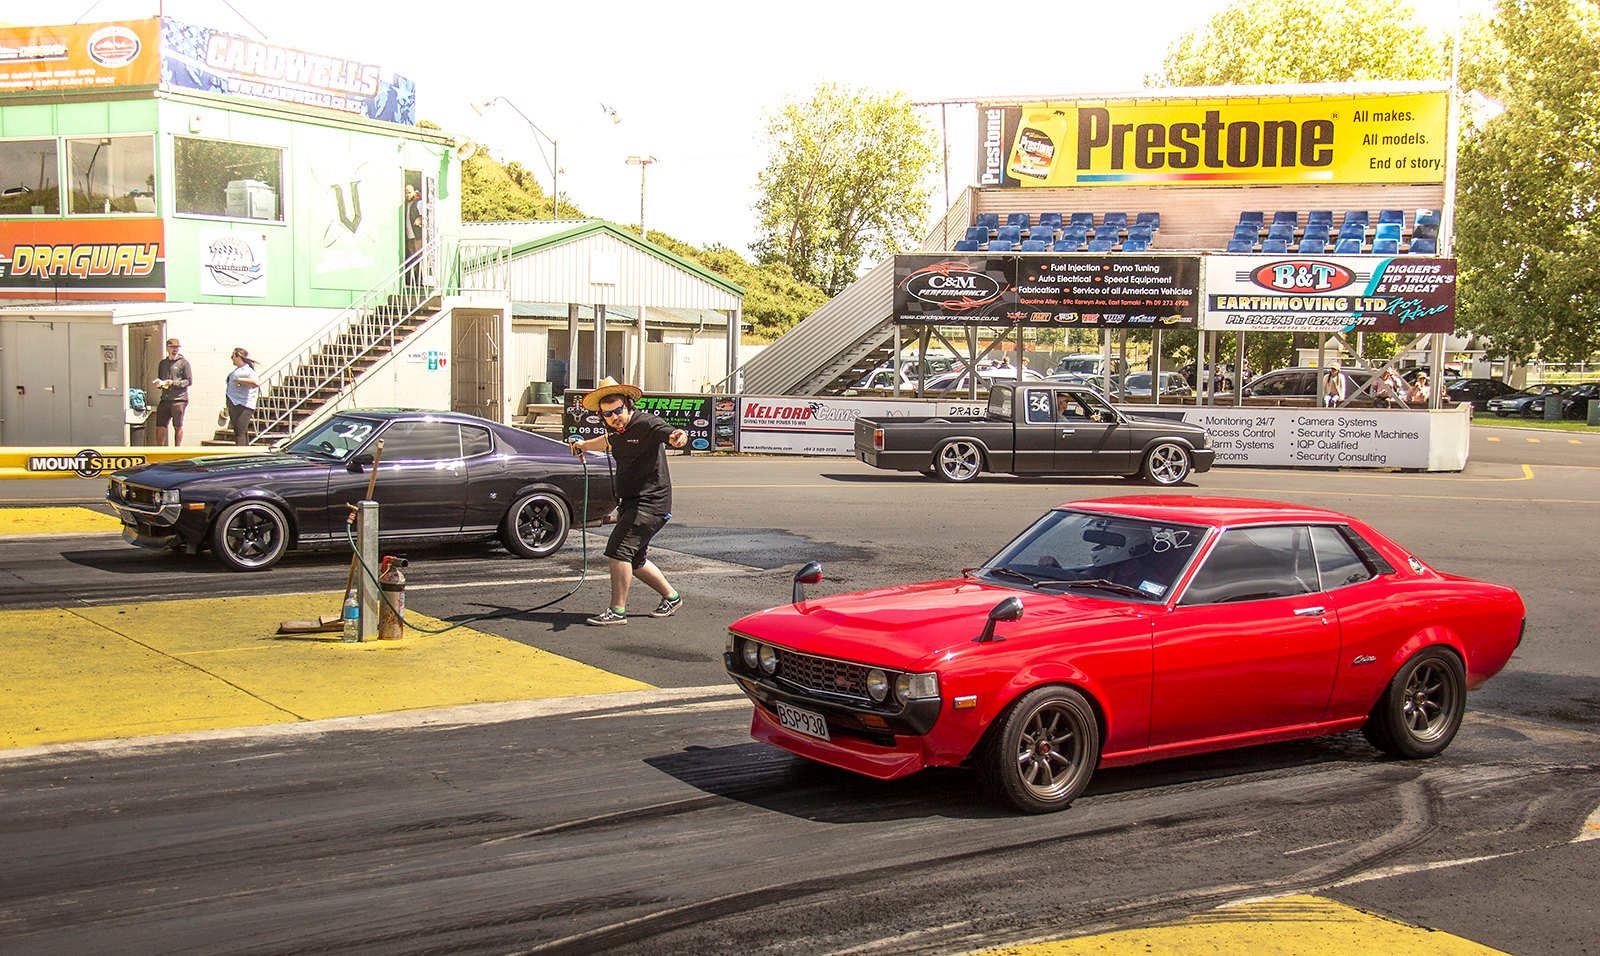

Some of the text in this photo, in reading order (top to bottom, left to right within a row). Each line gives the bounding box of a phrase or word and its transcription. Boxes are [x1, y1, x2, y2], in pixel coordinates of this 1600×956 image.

[206, 33, 380, 97] CARDWELLS
[1353, 110, 1415, 122] All makes.
[1076, 107, 1334, 170] Prestone
[1362, 132, 1429, 145] All models.
[982, 109, 1001, 184] Prestone
[1370, 156, 1444, 172] End of story.
[10, 243, 160, 279] DRAGWAY
[1068, 264, 1100, 272] Injection
[1113, 264, 1160, 274] Dyno Tuning
[1386, 264, 1441, 275] DIGGER'S
[928, 275, 977, 289] C&M
[1038, 275, 1092, 283] Auto Electrical
[1104, 276, 1172, 284] Speed Equipment
[1272, 264, 1336, 290] B&T
[1382, 274, 1454, 284] TIP TRUCK'S
[918, 289, 989, 297] PERFORMANCE
[1018, 286, 1060, 294] Fabrication
[1072, 286, 1100, 294] Service
[1102, 286, 1109, 294] of
[1122, 287, 1159, 295] American
[1160, 288, 1193, 296] Vehicles
[1376, 284, 1439, 293] & BOBCAT
[1216, 296, 1386, 312] EARTHMOVING LTD
[1386, 297, 1421, 315] For
[1400, 304, 1448, 324] Hire
[1226, 315, 1244, 325] Ph:
[1295, 316, 1308, 325] or
[1308, 316, 1376, 326] 0274-799-772
[634, 397, 705, 410] STREET
[1029, 395, 1050, 412] 36
[744, 402, 862, 422] KELFORD CAMS
[949, 406, 980, 416] DRAG
[1206, 416, 1275, 428] Monitoring 24/7
[1298, 416, 1378, 428] Camera Systems
[338, 424, 373, 442] 22
[1206, 428, 1276, 438] Access Control
[1297, 429, 1419, 440] Security Smoke Machines
[1210, 440, 1274, 451] larm Systems
[1297, 440, 1358, 450] IQP Qualified
[32, 457, 144, 470] MOUNT SHOP
[1296, 452, 1386, 464] Security Consulting
[1152, 530, 1192, 553] 82
